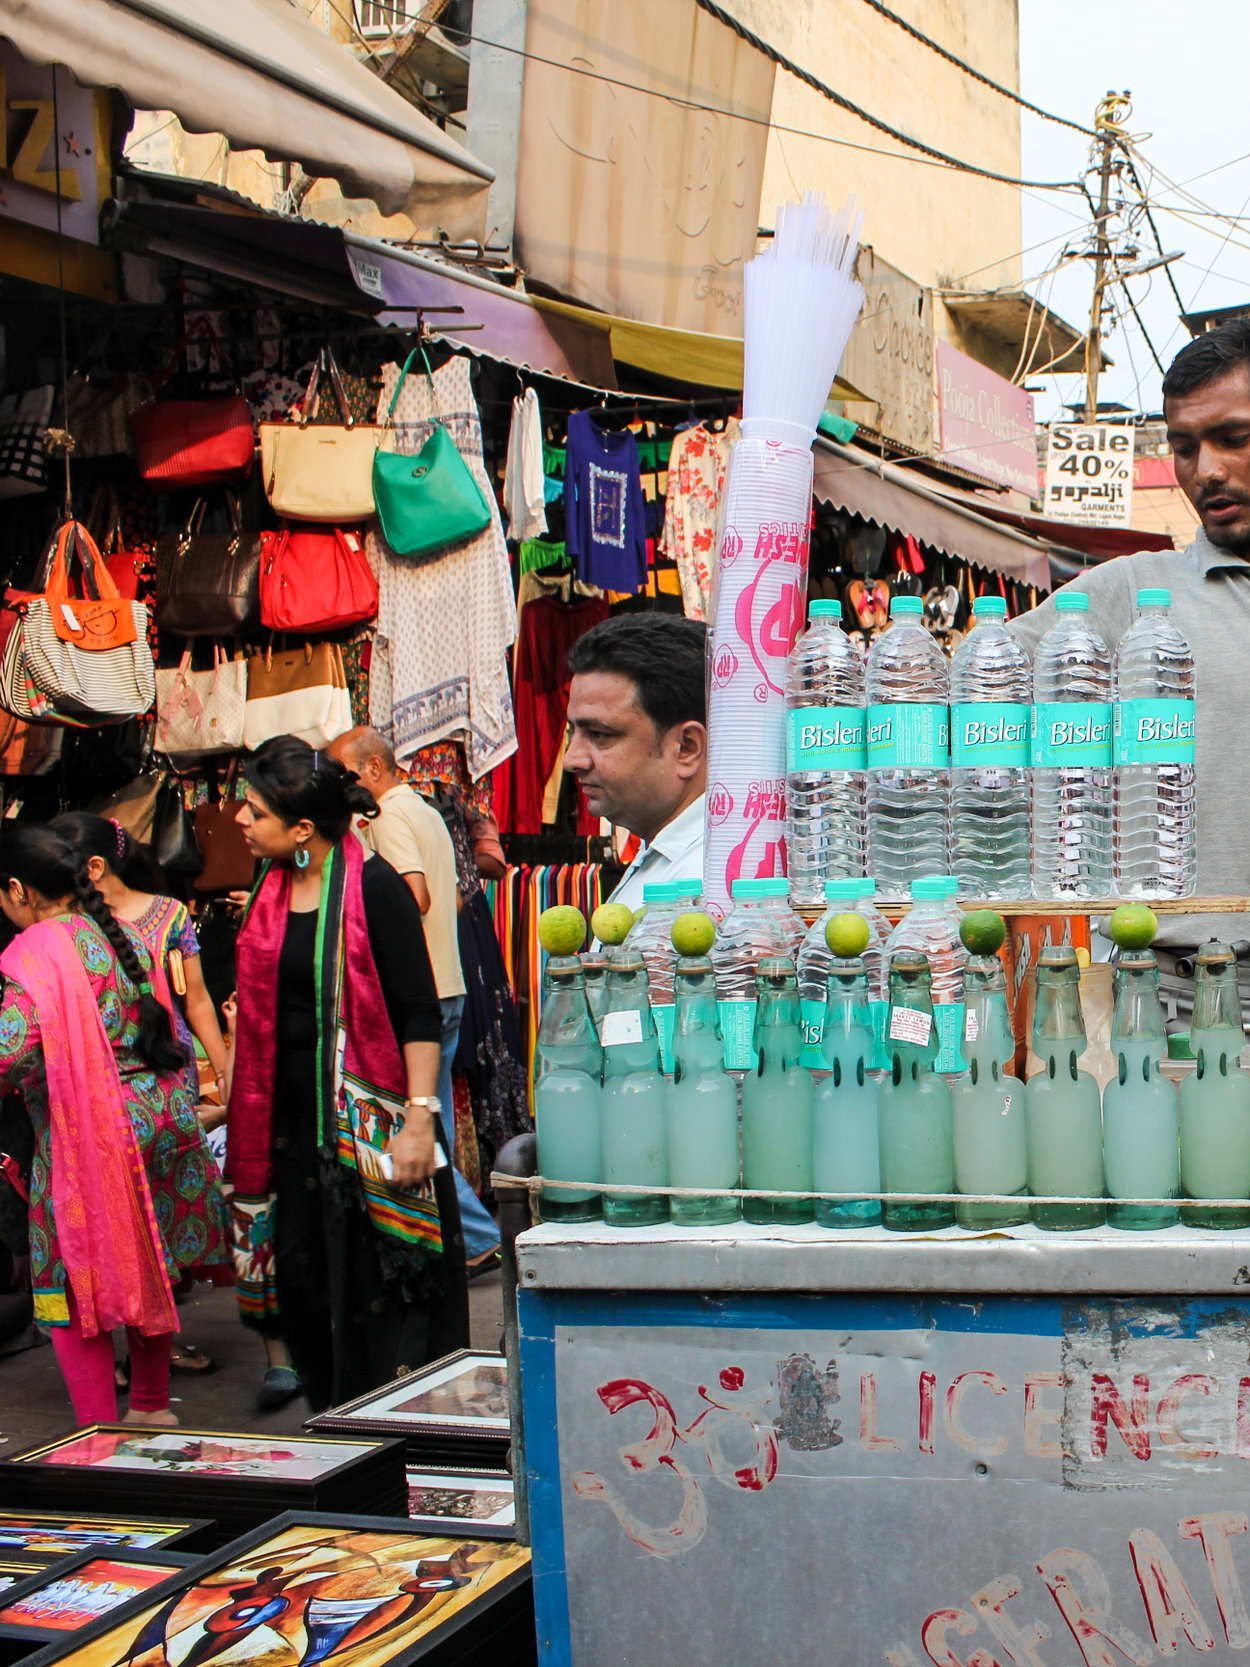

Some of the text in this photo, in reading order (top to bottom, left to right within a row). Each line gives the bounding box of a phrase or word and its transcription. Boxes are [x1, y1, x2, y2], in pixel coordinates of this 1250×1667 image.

[942, 367, 976, 435] Pooja
[978, 389, 1036, 454] Collections
[1052, 426, 1129, 452] Sale
[1059, 454, 1128, 478] 40%
[1081, 503, 1125, 512] GARMENTS
[800, 720, 863, 750] Bisleri
[964, 717, 1028, 747] Bisleri
